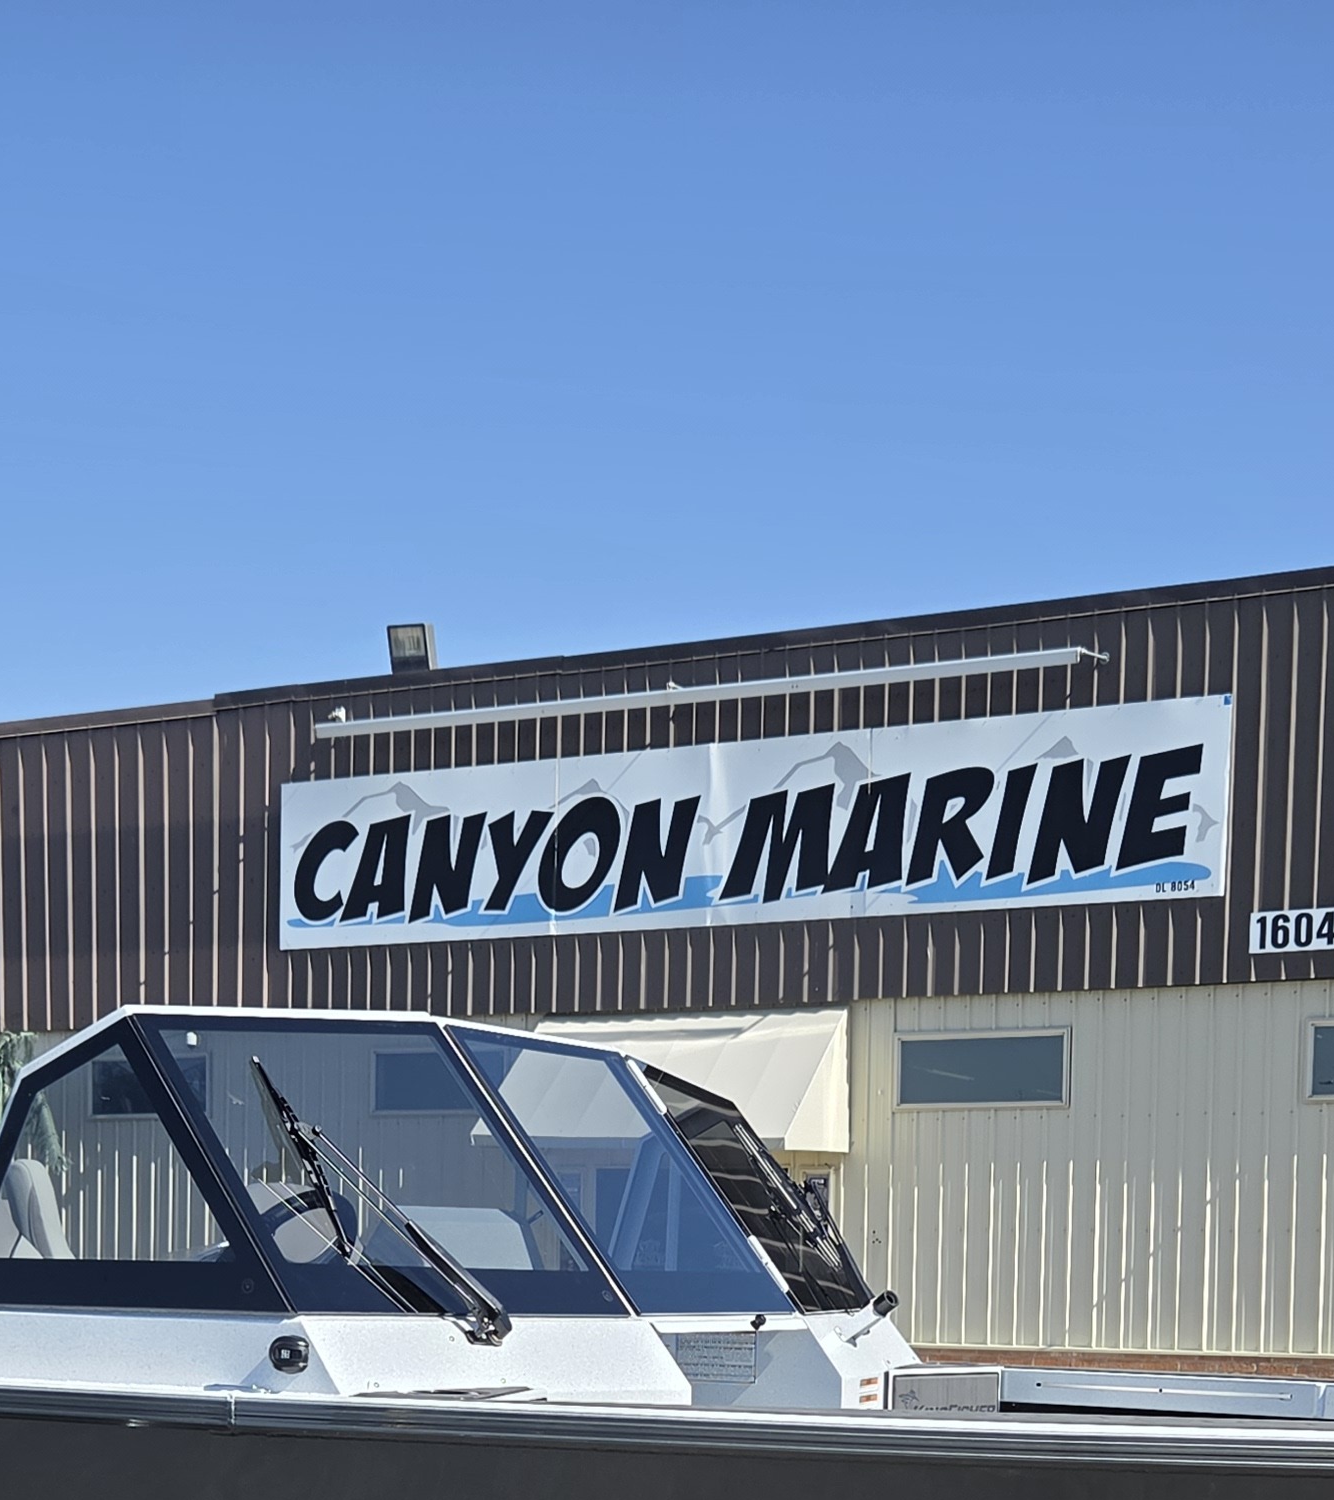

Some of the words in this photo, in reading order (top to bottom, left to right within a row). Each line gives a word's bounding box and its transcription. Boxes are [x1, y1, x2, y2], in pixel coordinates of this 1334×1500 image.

[294, 795, 702, 925] CANYON
[719, 743, 1204, 904] MARINE
[1155, 881, 1167, 894] DL
[1170, 880, 1196, 892] 8054
